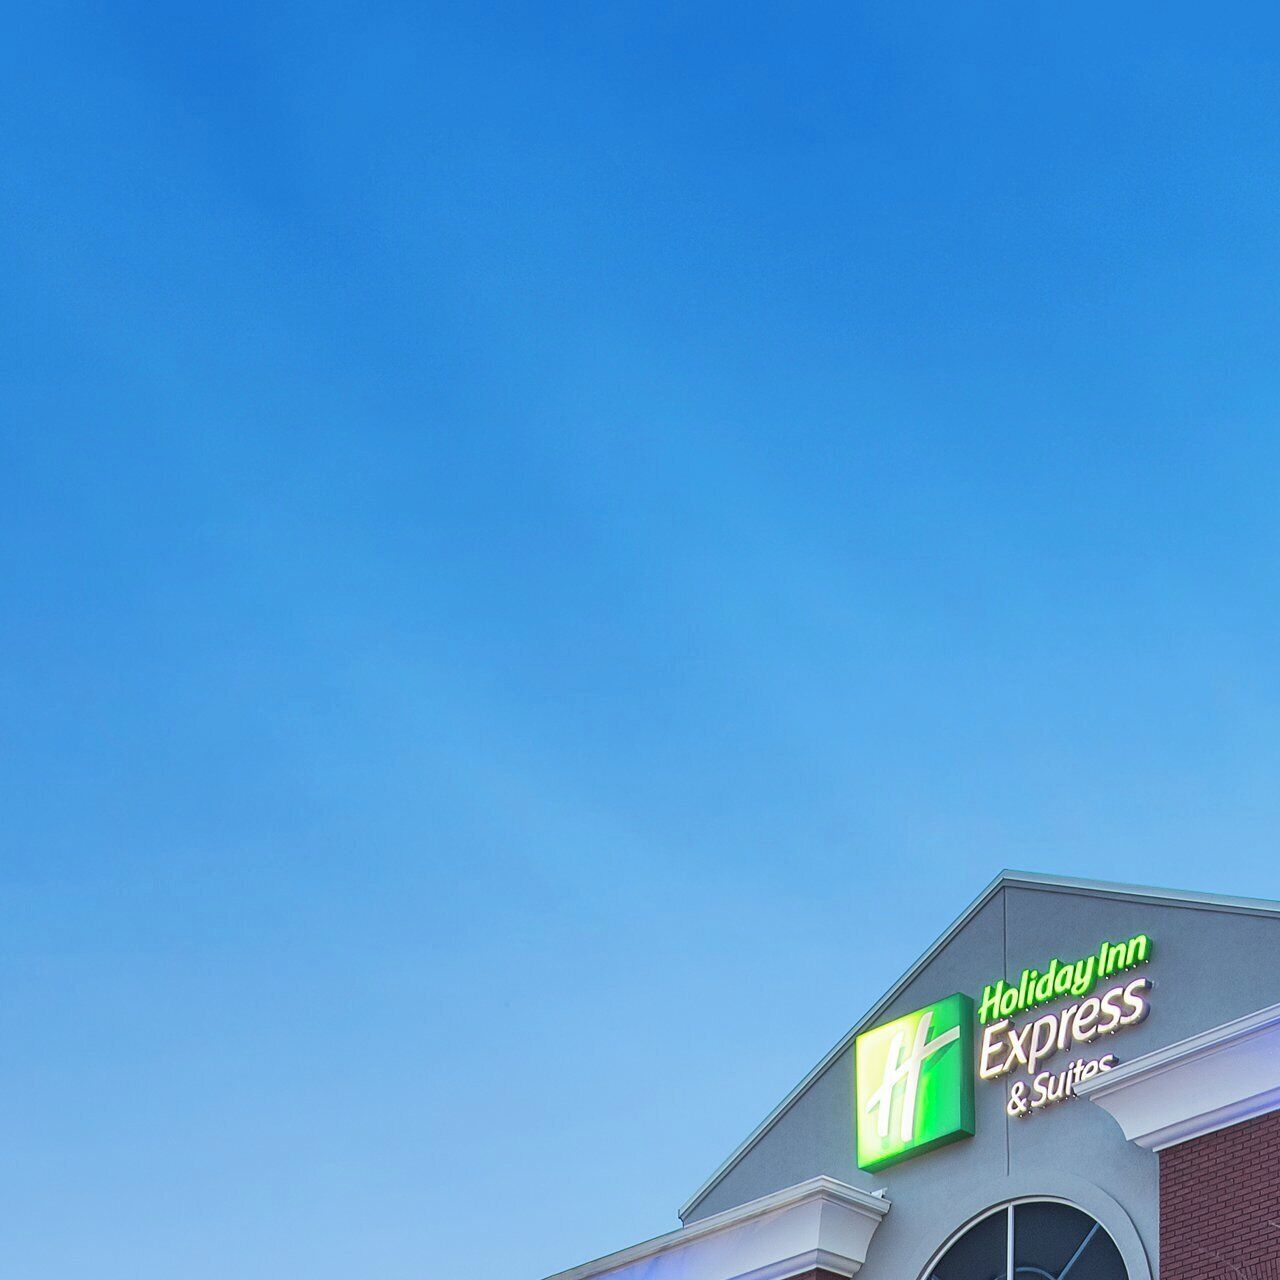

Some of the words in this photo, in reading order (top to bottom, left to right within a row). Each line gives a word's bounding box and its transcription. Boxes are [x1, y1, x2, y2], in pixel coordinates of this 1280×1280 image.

[978, 955, 1096, 1024] Holiday
[1097, 933, 1150, 979] Inn
[978, 978, 1152, 1079] Express
[1007, 1081, 1029, 1116] &
